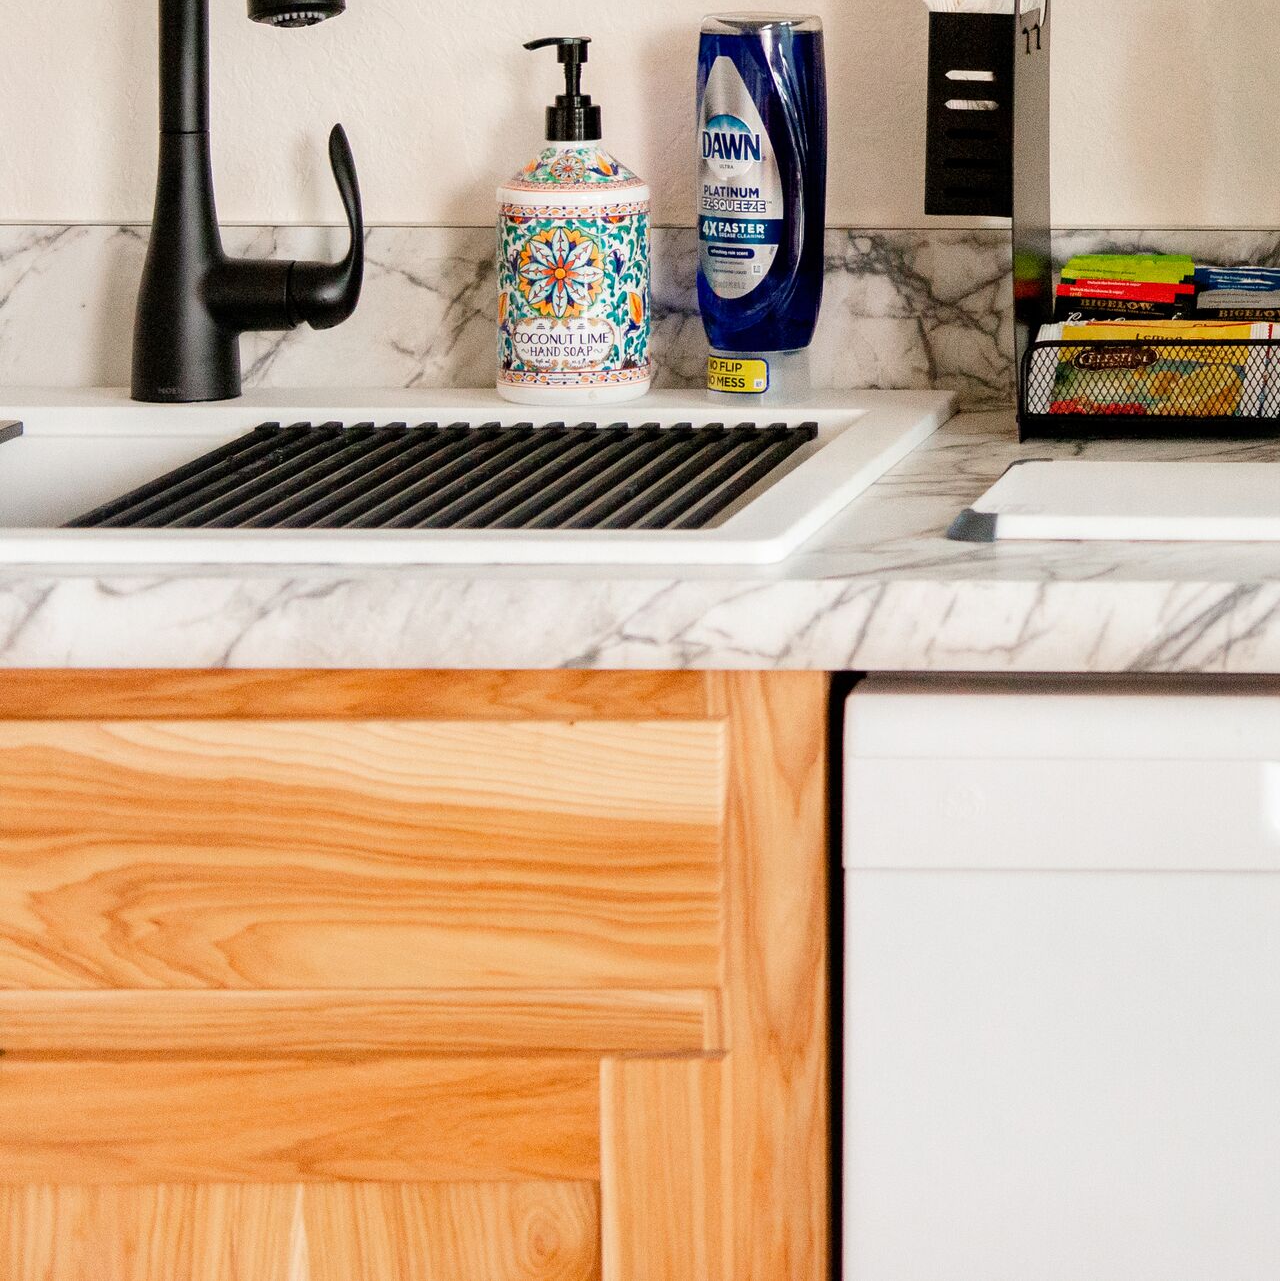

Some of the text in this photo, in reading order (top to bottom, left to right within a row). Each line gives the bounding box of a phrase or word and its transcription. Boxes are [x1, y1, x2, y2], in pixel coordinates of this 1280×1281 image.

[702, 130, 761, 161] DAWN
[704, 185, 760, 199] PLATINUM
[702, 221, 764, 237] 4X FASTER
[1081, 299, 1153, 311] BIGELOW
[514, 333, 609, 345] COCONUT LIME
[530, 346, 593, 357] HAND SOAP
[720, 362, 742, 372] FLIP
[717, 376, 745, 388] MESS
